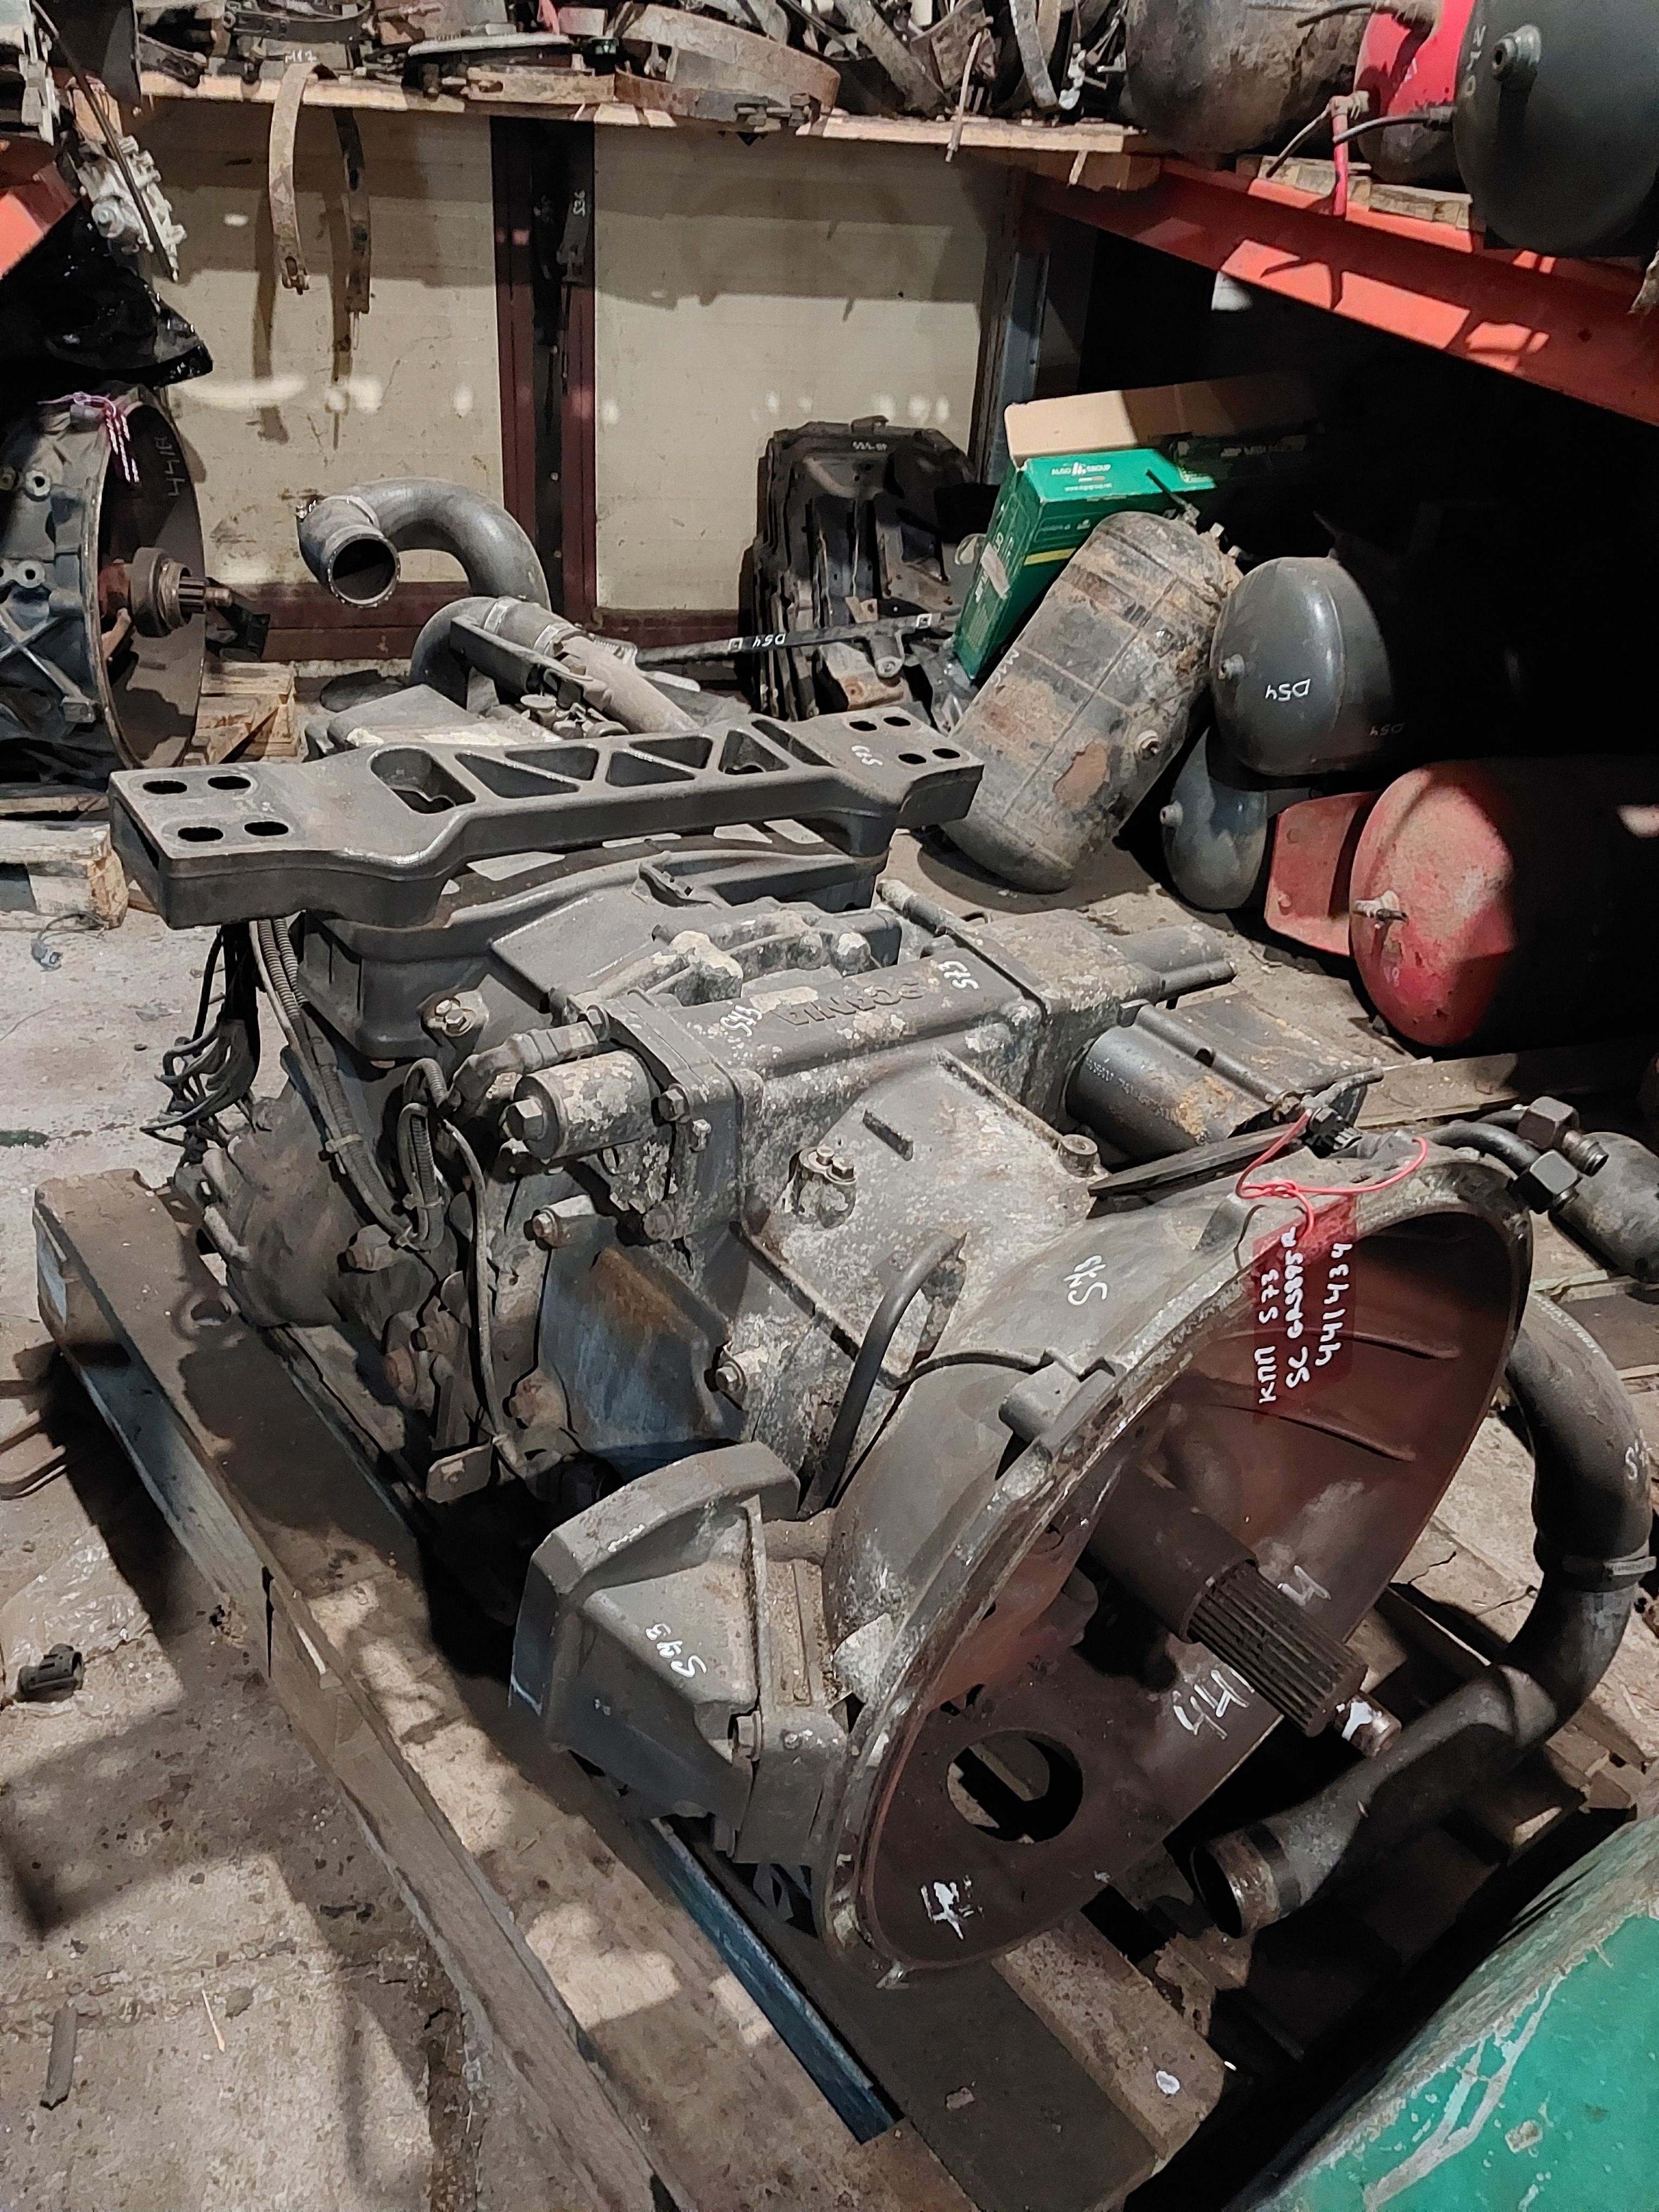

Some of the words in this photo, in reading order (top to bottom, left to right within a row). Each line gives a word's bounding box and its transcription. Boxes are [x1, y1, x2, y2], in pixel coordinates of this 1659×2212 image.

[752, 633, 786, 649] D54
[1264, 678, 1311, 701] D54
[770, 982, 925, 1027] SCANIA
[1315, 1243, 1353, 1367] 441434
[1285, 1346, 1310, 1389] SC
